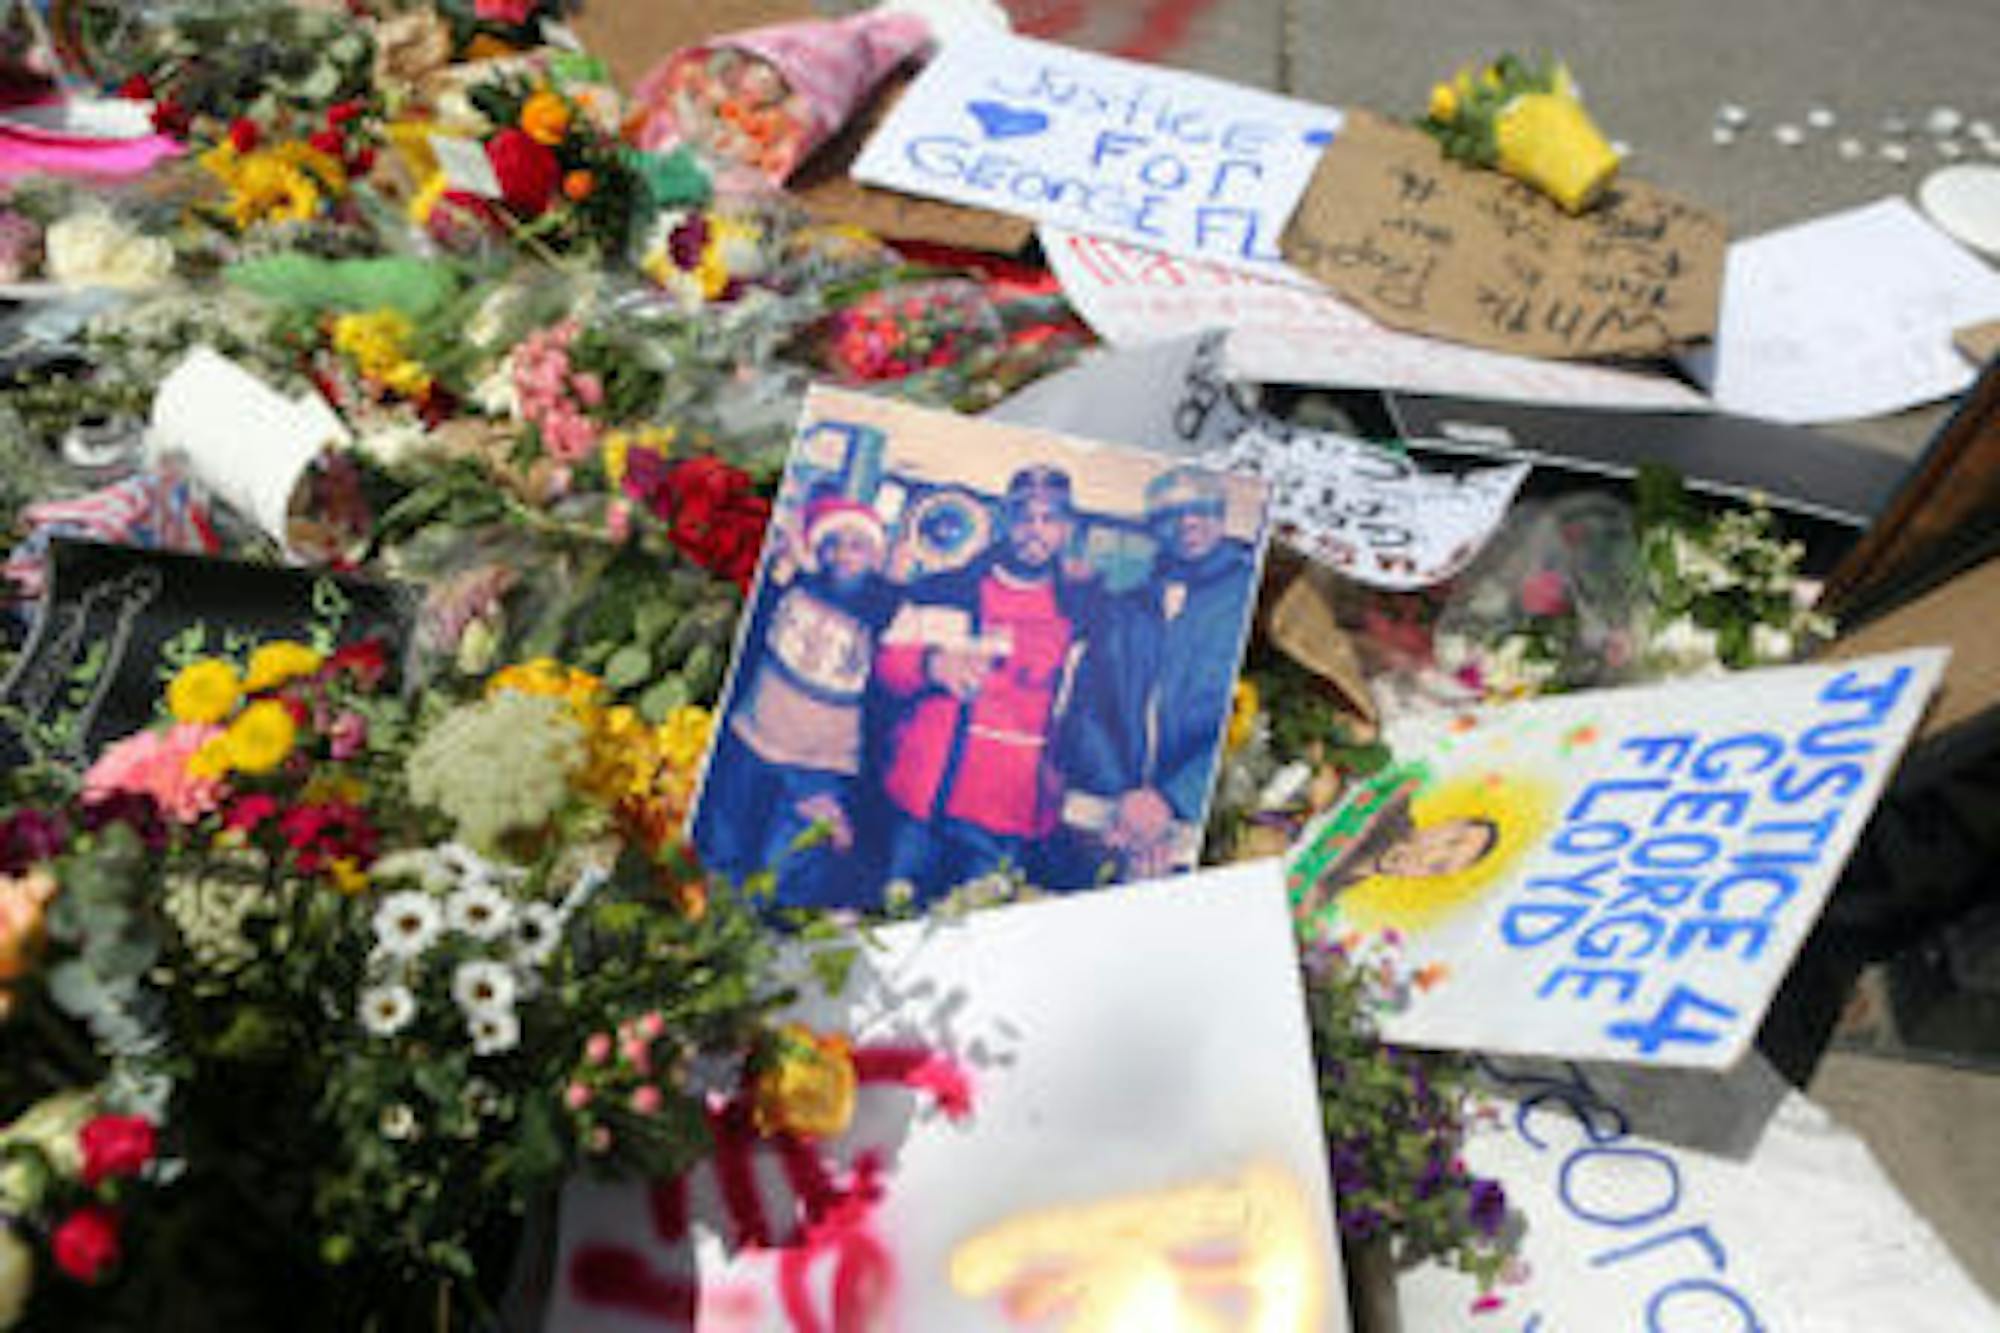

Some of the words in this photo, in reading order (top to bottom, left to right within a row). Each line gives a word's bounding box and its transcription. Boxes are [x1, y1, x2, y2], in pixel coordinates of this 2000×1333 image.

[1499, 732, 1693, 947] FLOYD
[1536, 732, 1787, 1000] GEORGE
[1663, 666, 1913, 961] JUSTICE
[1606, 983, 1738, 1054] 4
